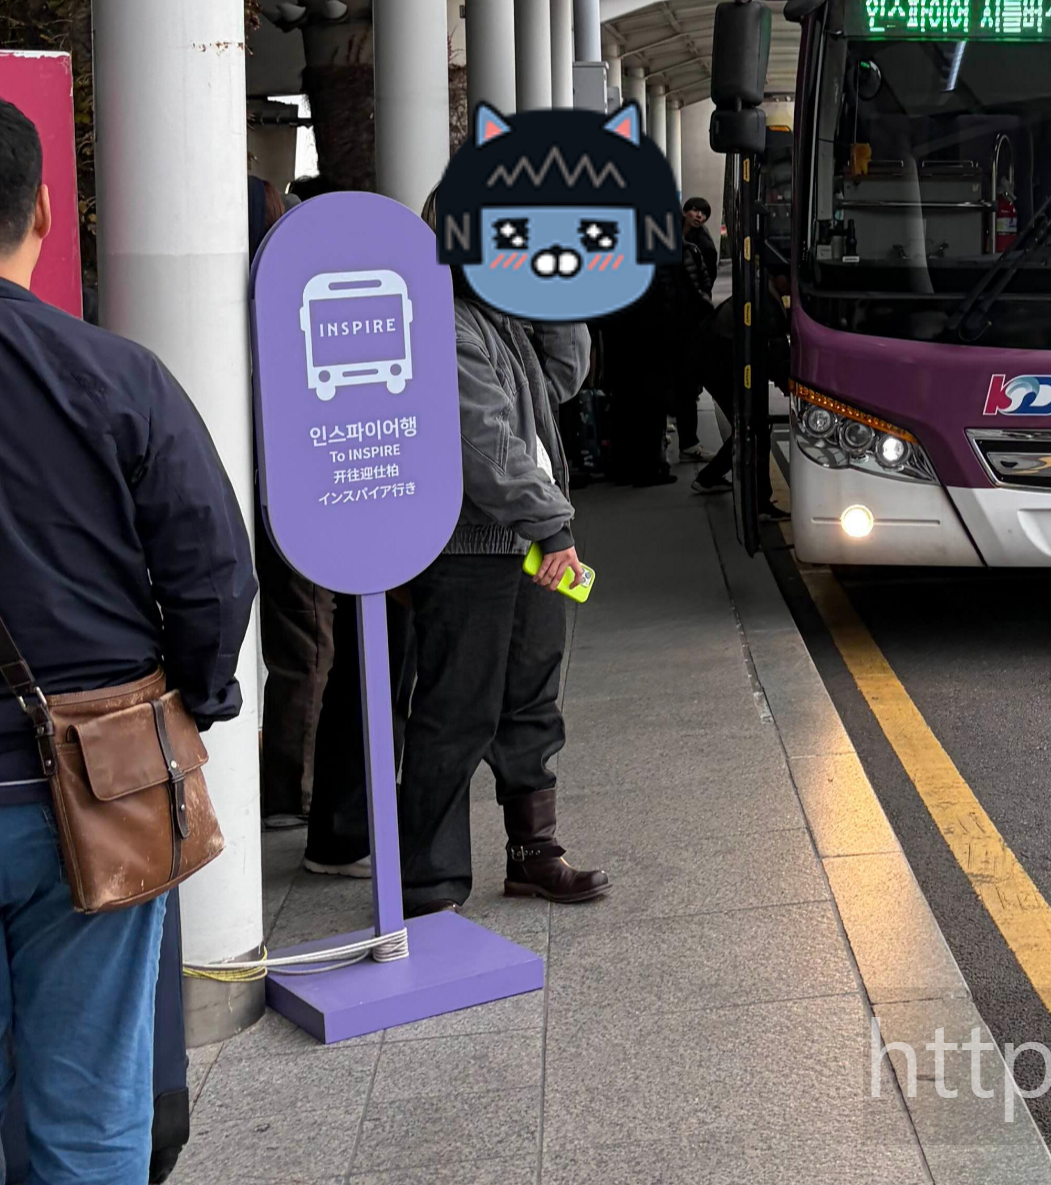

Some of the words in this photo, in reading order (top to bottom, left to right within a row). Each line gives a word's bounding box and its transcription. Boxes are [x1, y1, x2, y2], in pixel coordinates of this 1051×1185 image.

[319, 318, 396, 337] INSPIRE
[309, 416, 418, 447] 인스파이어행
[330, 450, 345, 463] To
[349, 444, 401, 461] INSPIRE
[333, 463, 399, 484] 开往迎仕柏
[318, 482, 416, 506] インスパイア行き
